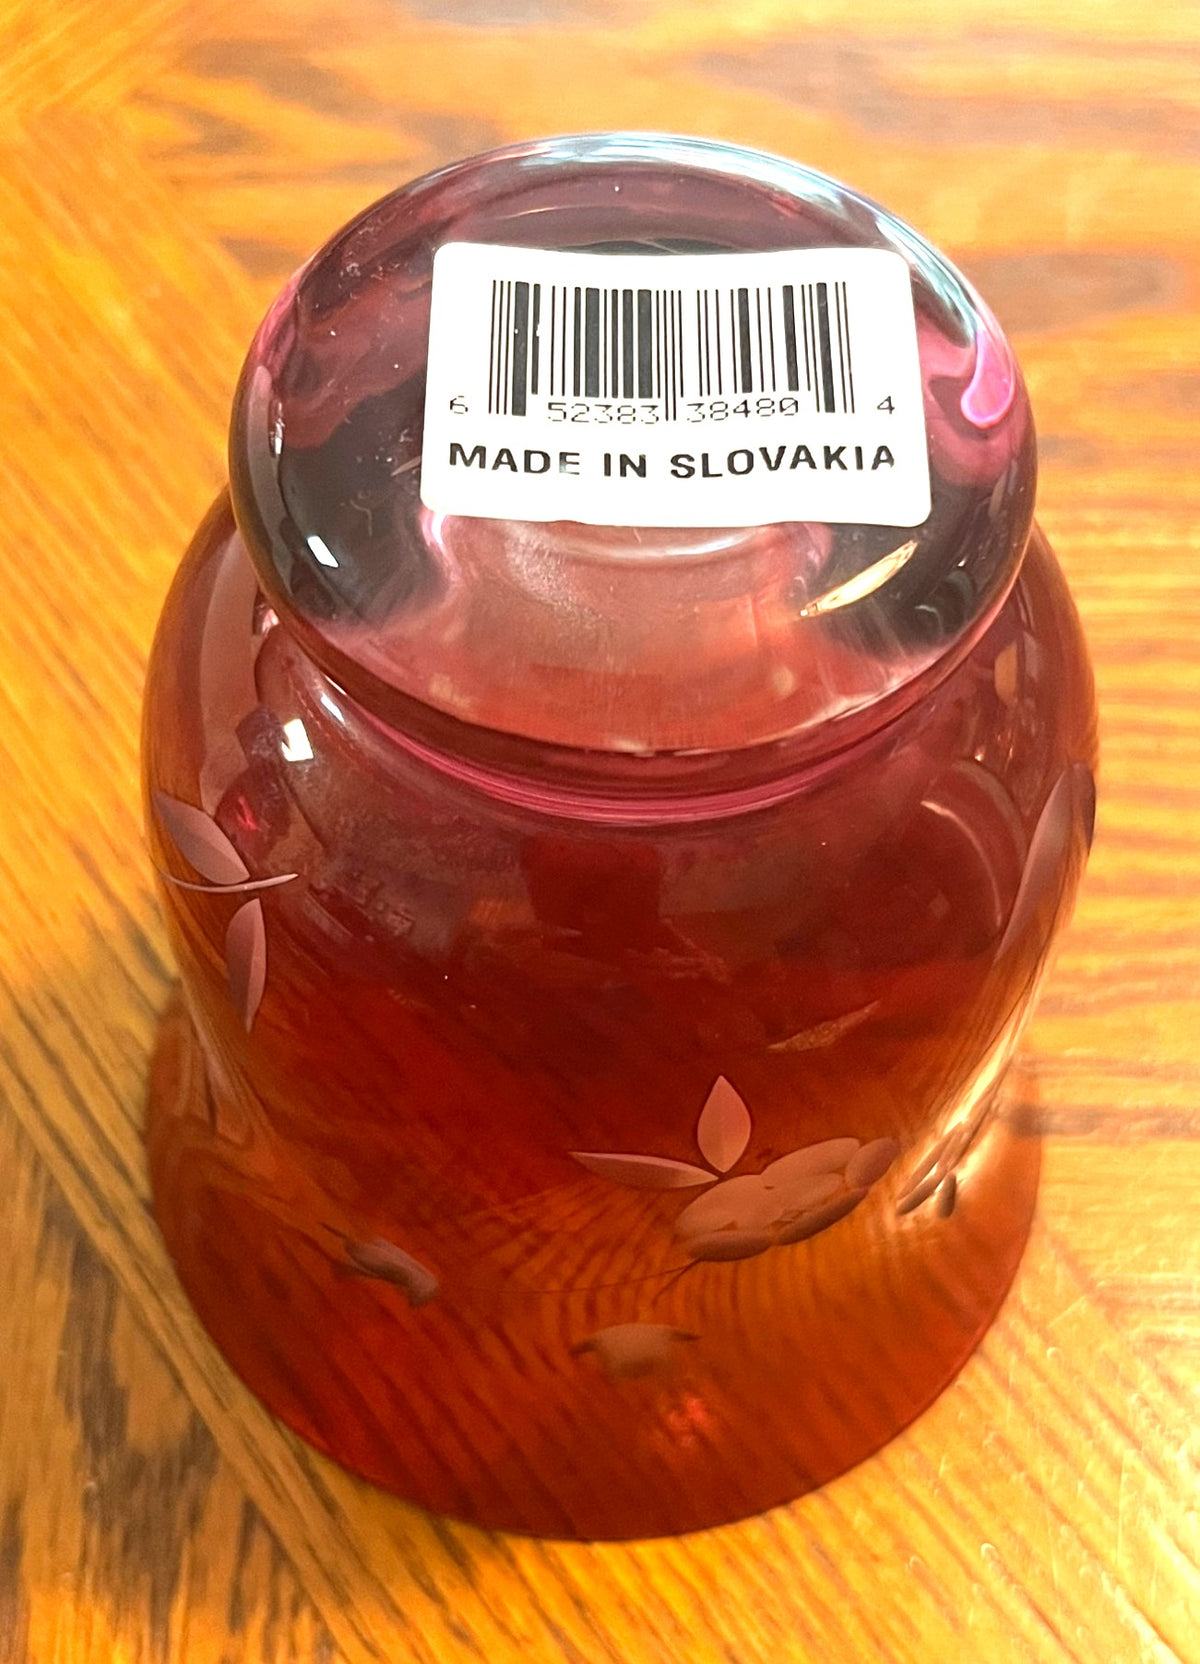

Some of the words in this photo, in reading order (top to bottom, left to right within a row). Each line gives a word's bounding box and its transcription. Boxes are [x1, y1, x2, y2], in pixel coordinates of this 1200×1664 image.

[449, 395, 469, 415] 6
[547, 402, 660, 425] 52383
[686, 397, 799, 423] 38480
[876, 395, 896, 415] 4
[449, 442, 581, 476] MADE
[603, 452, 647, 478] IN
[669, 444, 896, 479] SLOVAKIA
